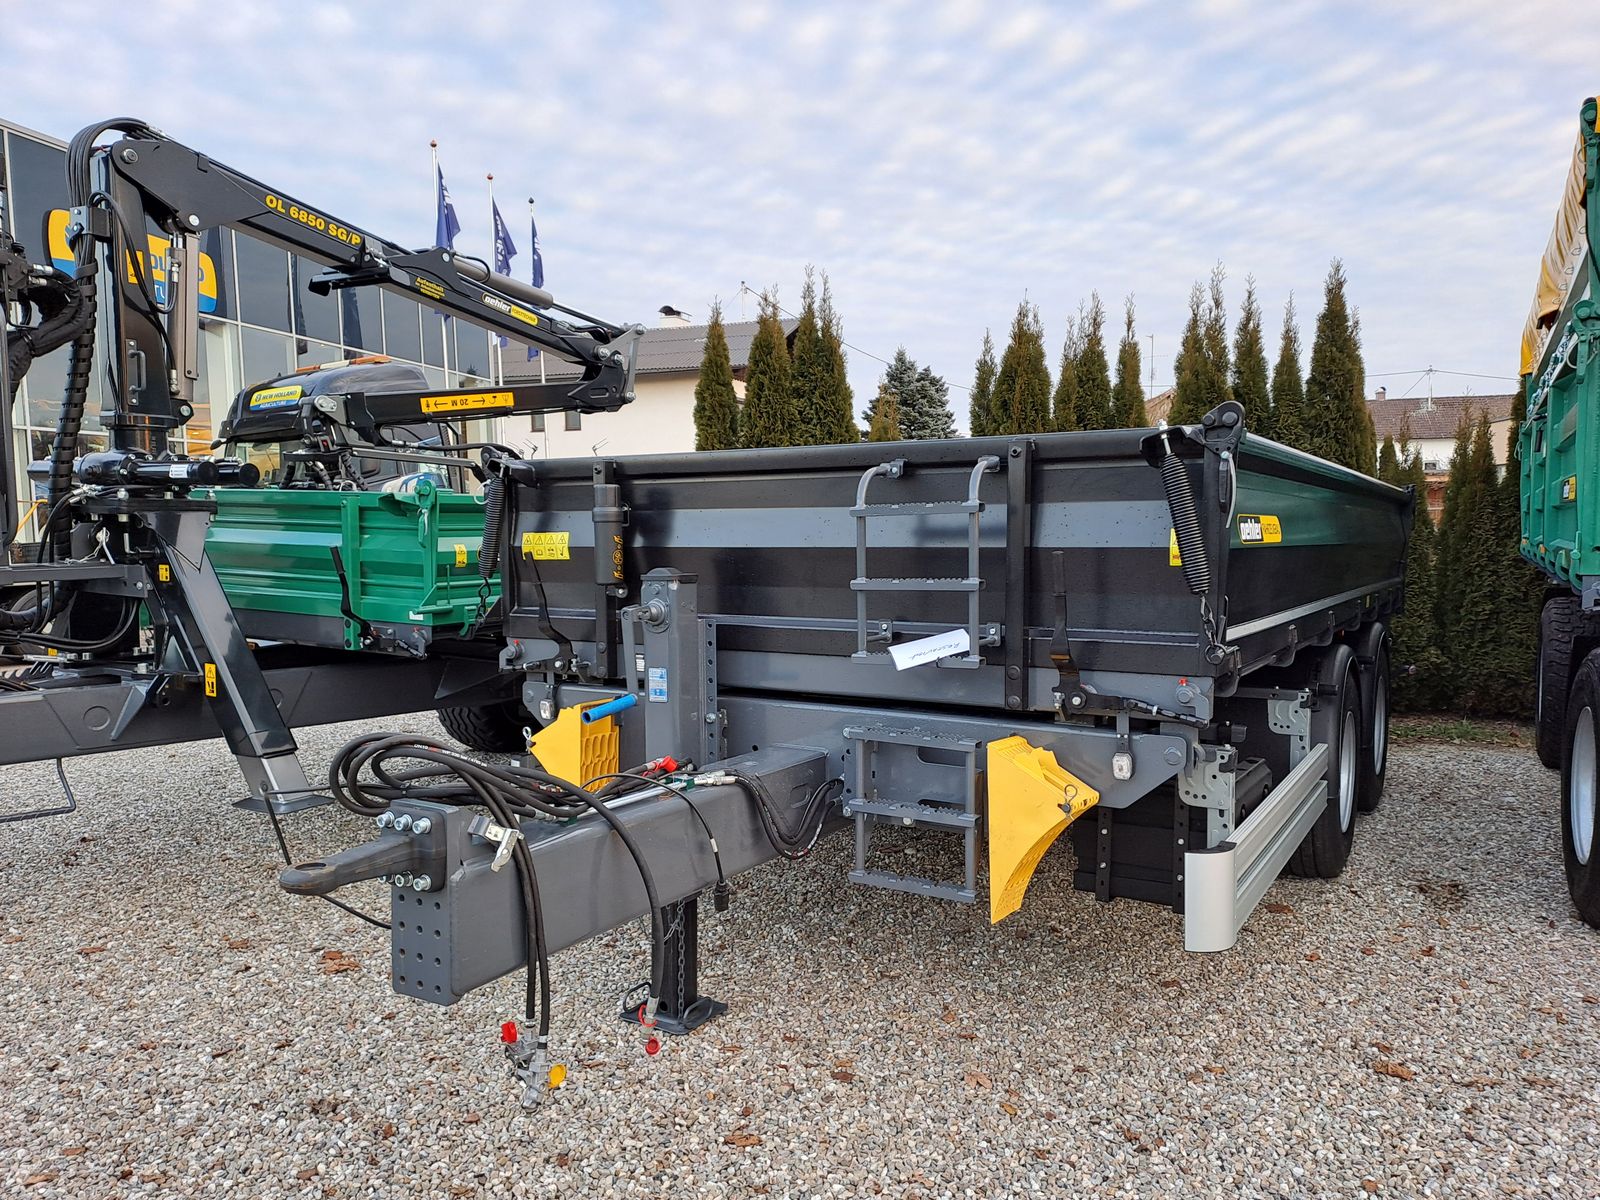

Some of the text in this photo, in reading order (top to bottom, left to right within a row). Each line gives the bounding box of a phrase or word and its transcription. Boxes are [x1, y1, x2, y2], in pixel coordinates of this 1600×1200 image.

[265, 195, 361, 246] OL 6850 SG/P
[485, 295, 511, 312] oehler
[274, 390, 298, 398] HOLLAND
[451, 398, 469, 407] 20 M
[1240, 518, 1262, 540] oehler
